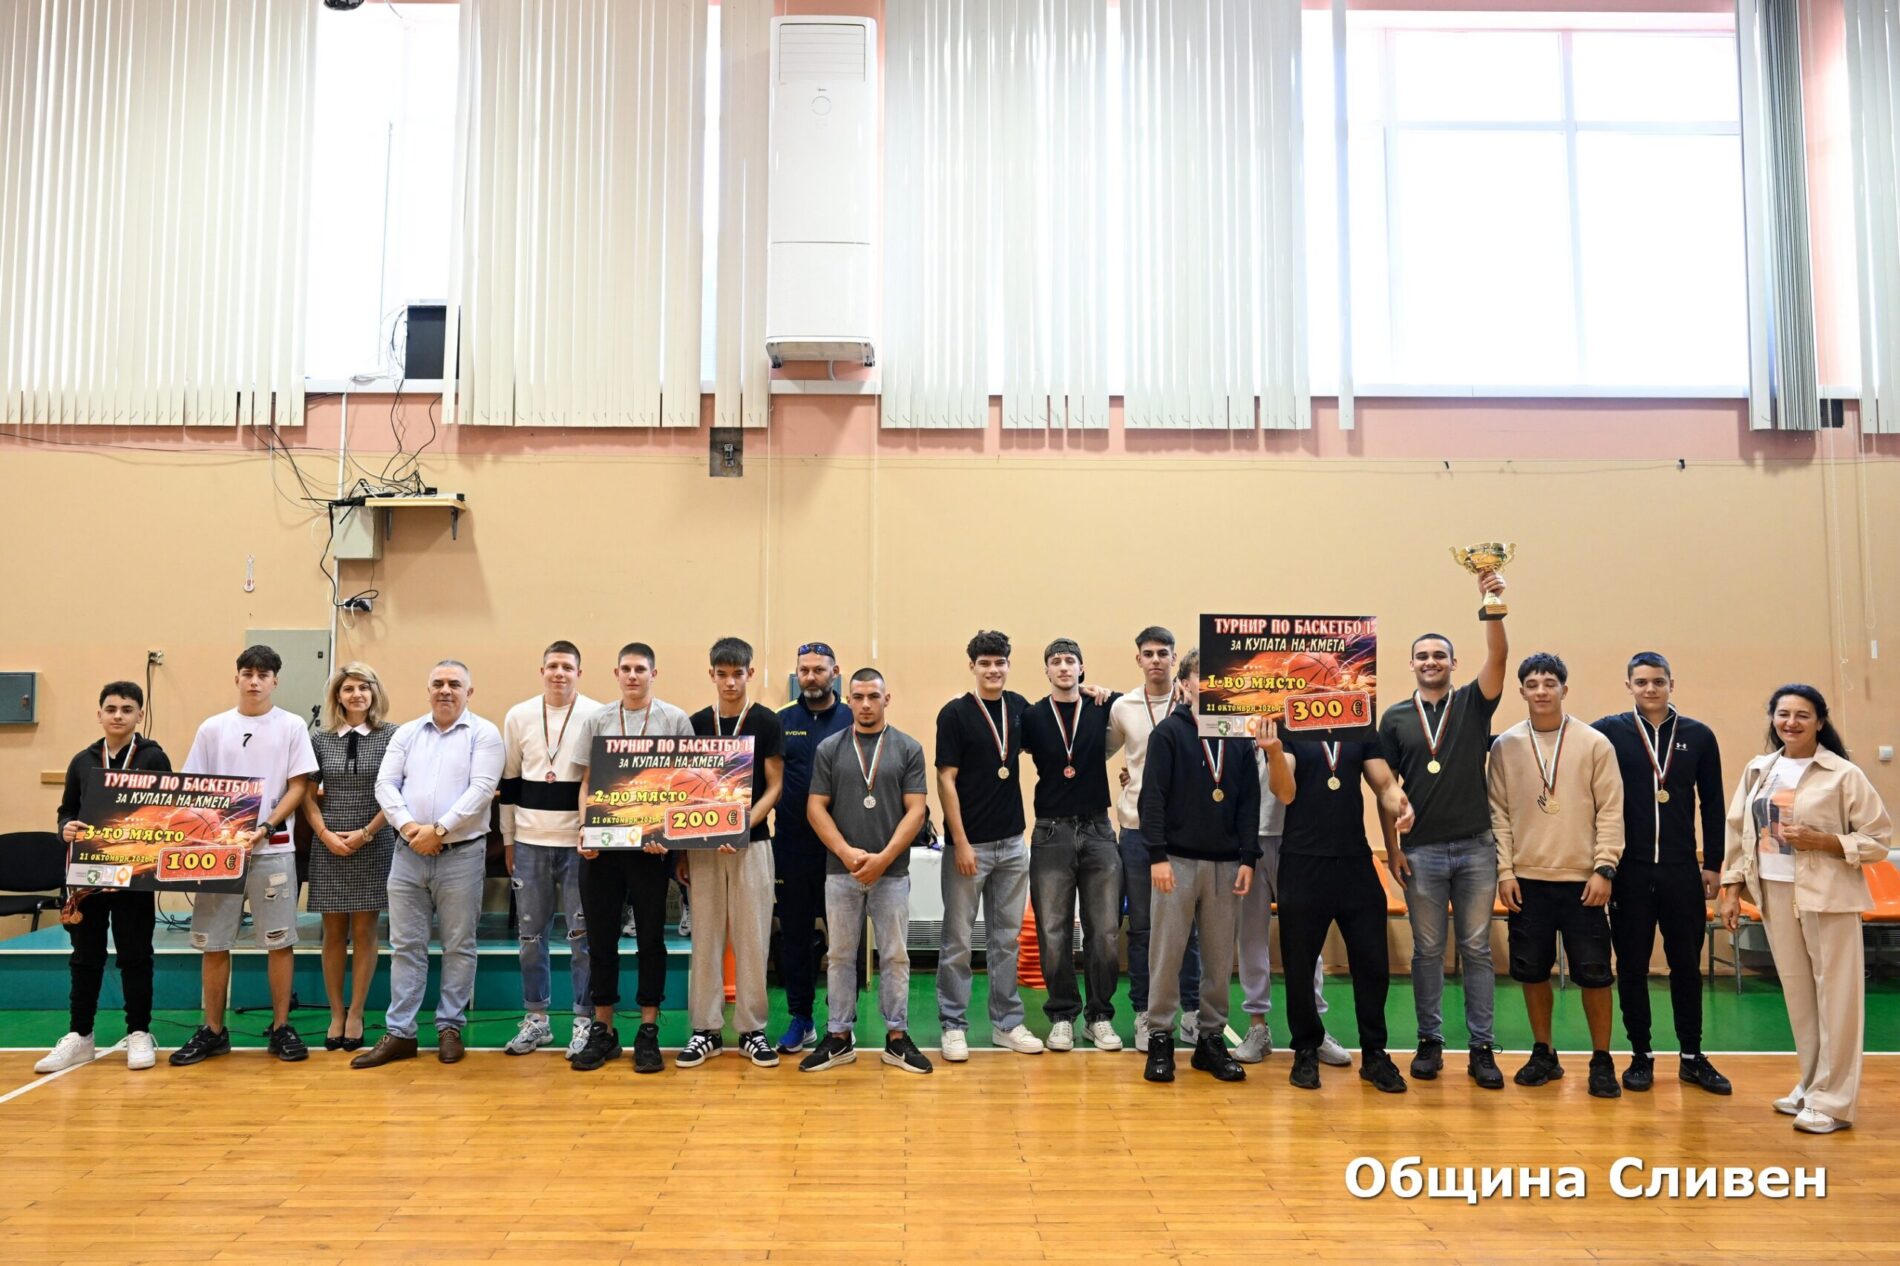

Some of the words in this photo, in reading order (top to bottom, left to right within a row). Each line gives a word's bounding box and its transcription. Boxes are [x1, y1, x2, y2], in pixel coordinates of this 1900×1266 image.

[1214, 618, 1267, 634] ТУРНИР
[1271, 618, 1290, 635] ПО
[1244, 638, 1287, 651] КУПАТА
[1291, 638, 1306, 652] НА
[1309, 638, 1345, 652] КМЕТА
[1206, 703, 1215, 712] 21
[1292, 699, 1343, 721] 300
[1351, 699, 1363, 717] €
[242, 733, 253, 747] 7
[605, 739, 654, 753] ТУРНИР
[656, 739, 675, 753] ПО
[631, 755, 671, 768] КУПАТА
[674, 756, 688, 768] НА
[691, 756, 725, 768] КМЕТА
[103, 771, 157, 789] ТУРНИР
[159, 775, 180, 791] ПО
[130, 791, 173, 806] КУПАТА
[176, 794, 192, 807] НА
[194, 795, 231, 809] КМЕТА
[591, 816, 600, 824] 21
[671, 810, 720, 829] 200
[726, 810, 738, 826] €
[79, 852, 88, 861] 21
[165, 852, 217, 871] 100
[224, 853, 237, 870] €
